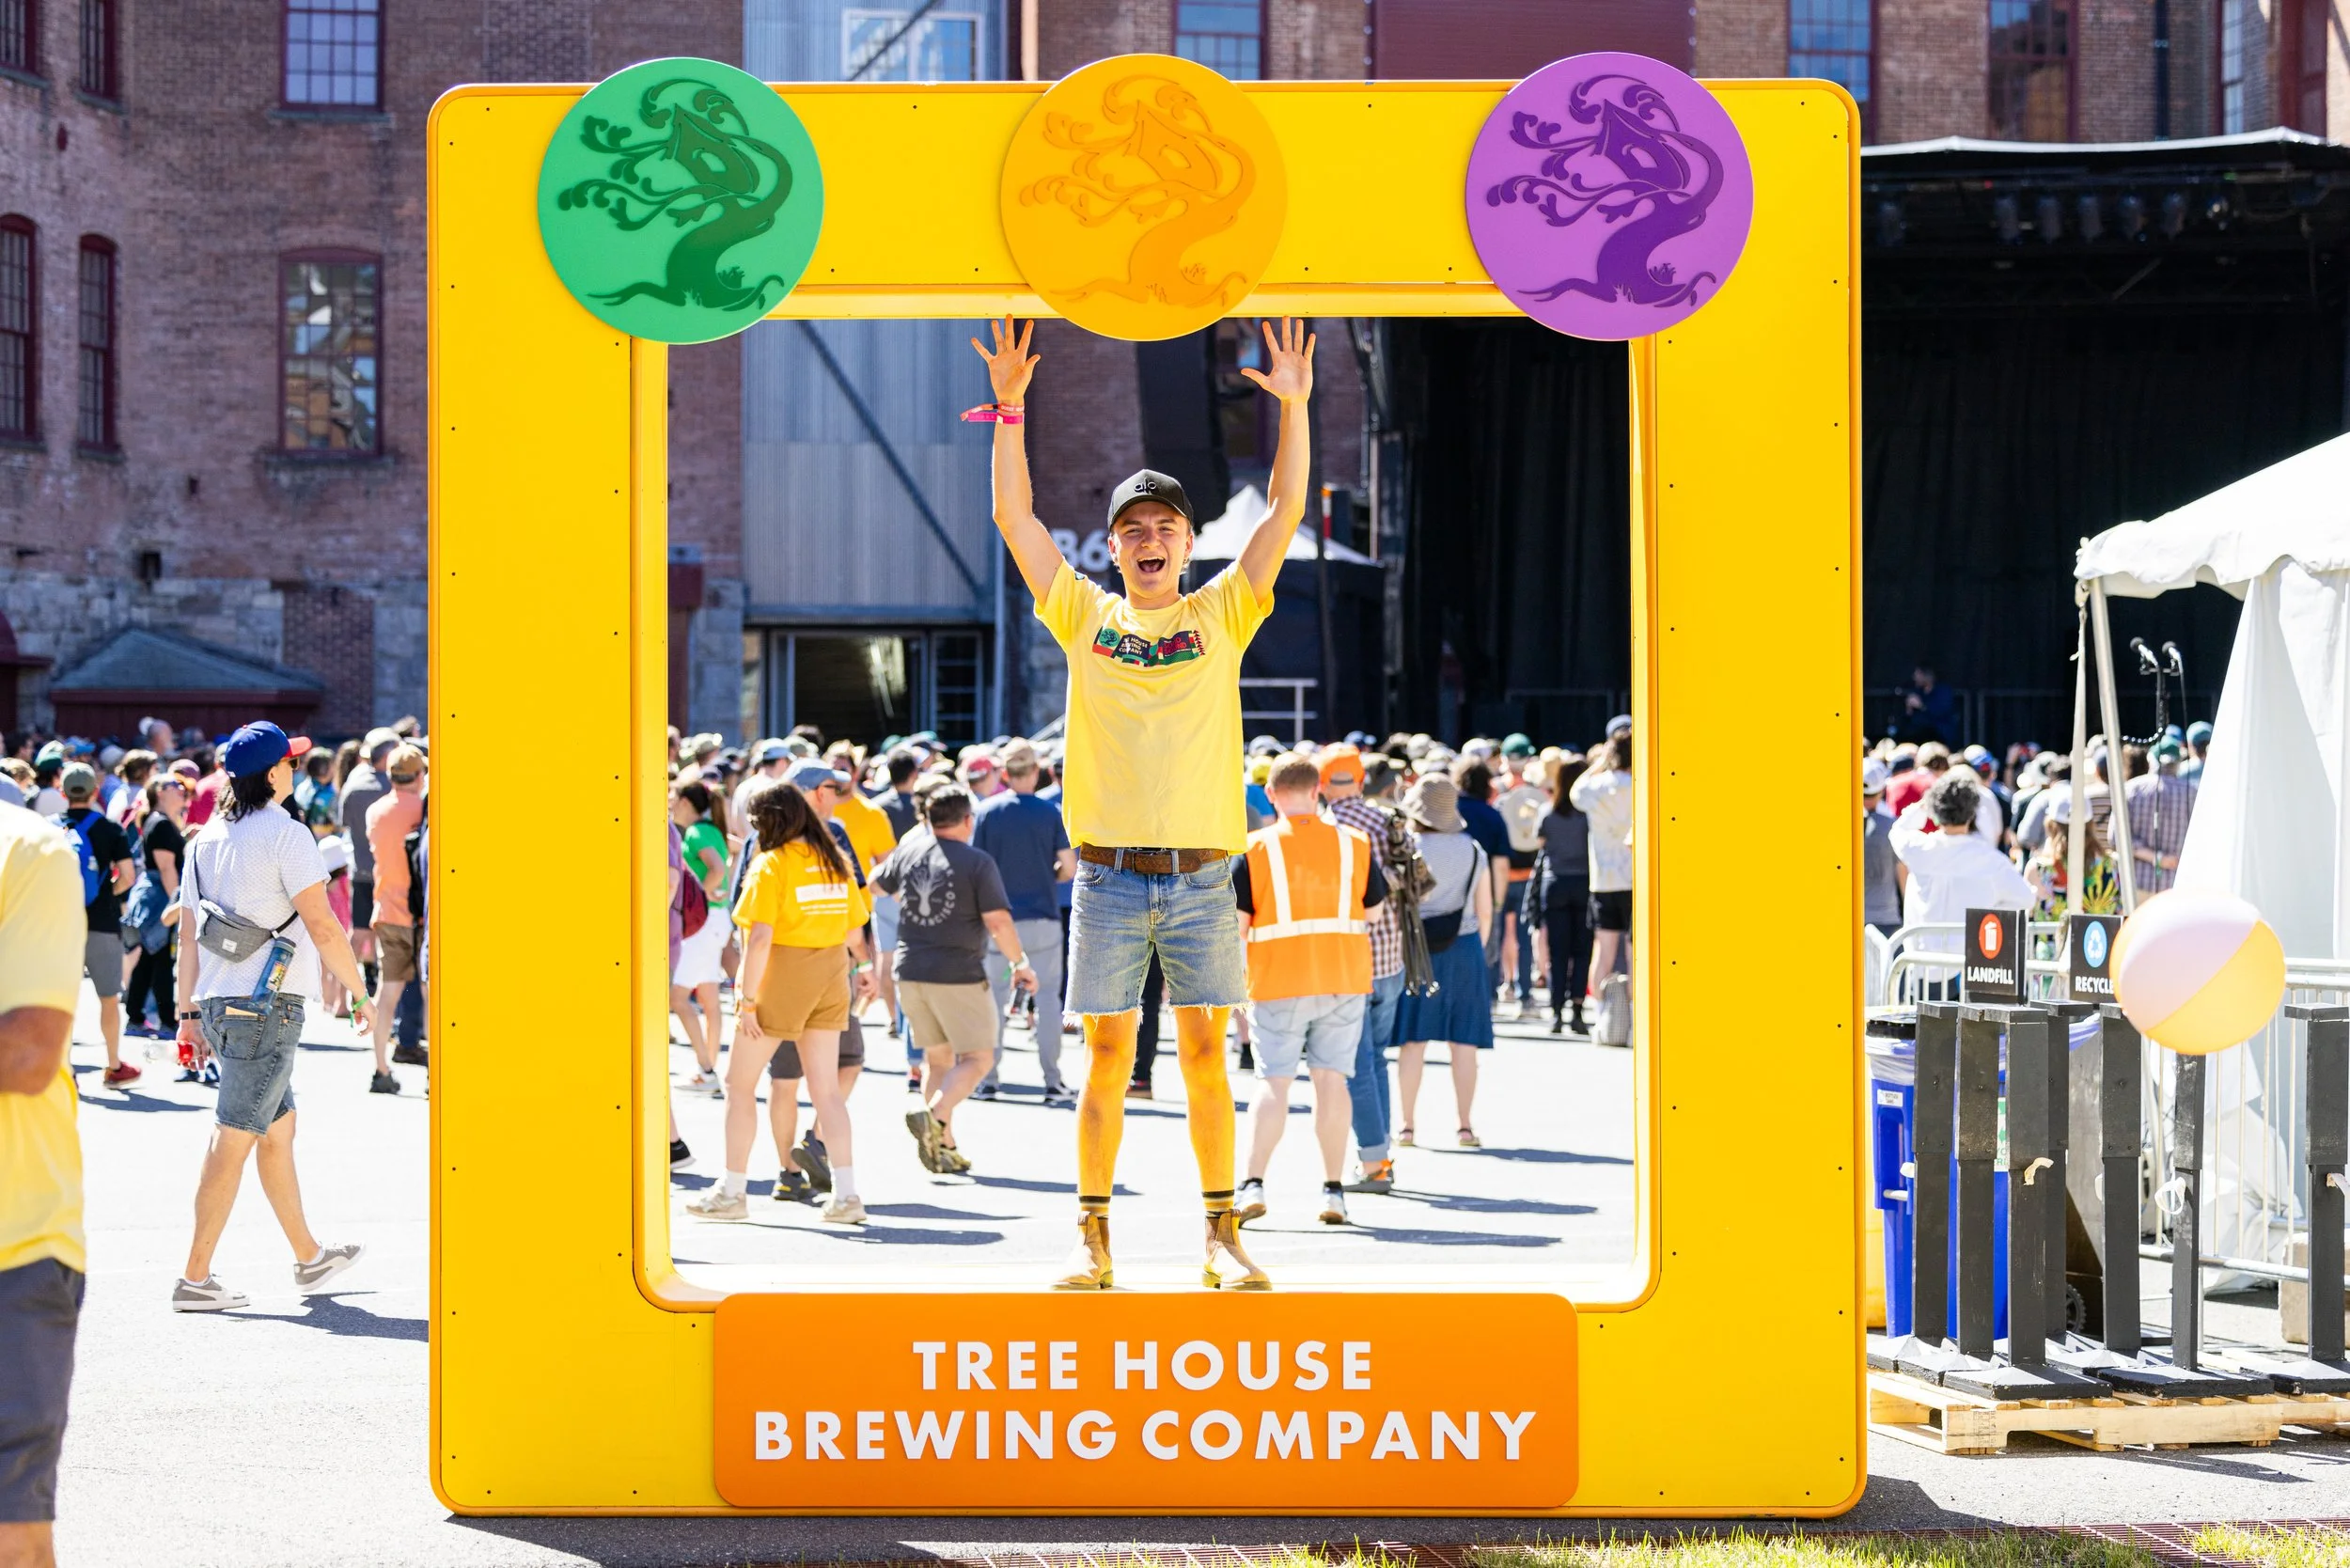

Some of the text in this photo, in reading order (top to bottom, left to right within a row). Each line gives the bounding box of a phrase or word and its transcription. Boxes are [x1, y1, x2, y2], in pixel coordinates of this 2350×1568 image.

[1967, 965, 2014, 985] LANDFILL
[913, 1340, 1371, 1390] TREE HOUSE
[756, 1410, 1535, 1460] BREWING COMPANY
